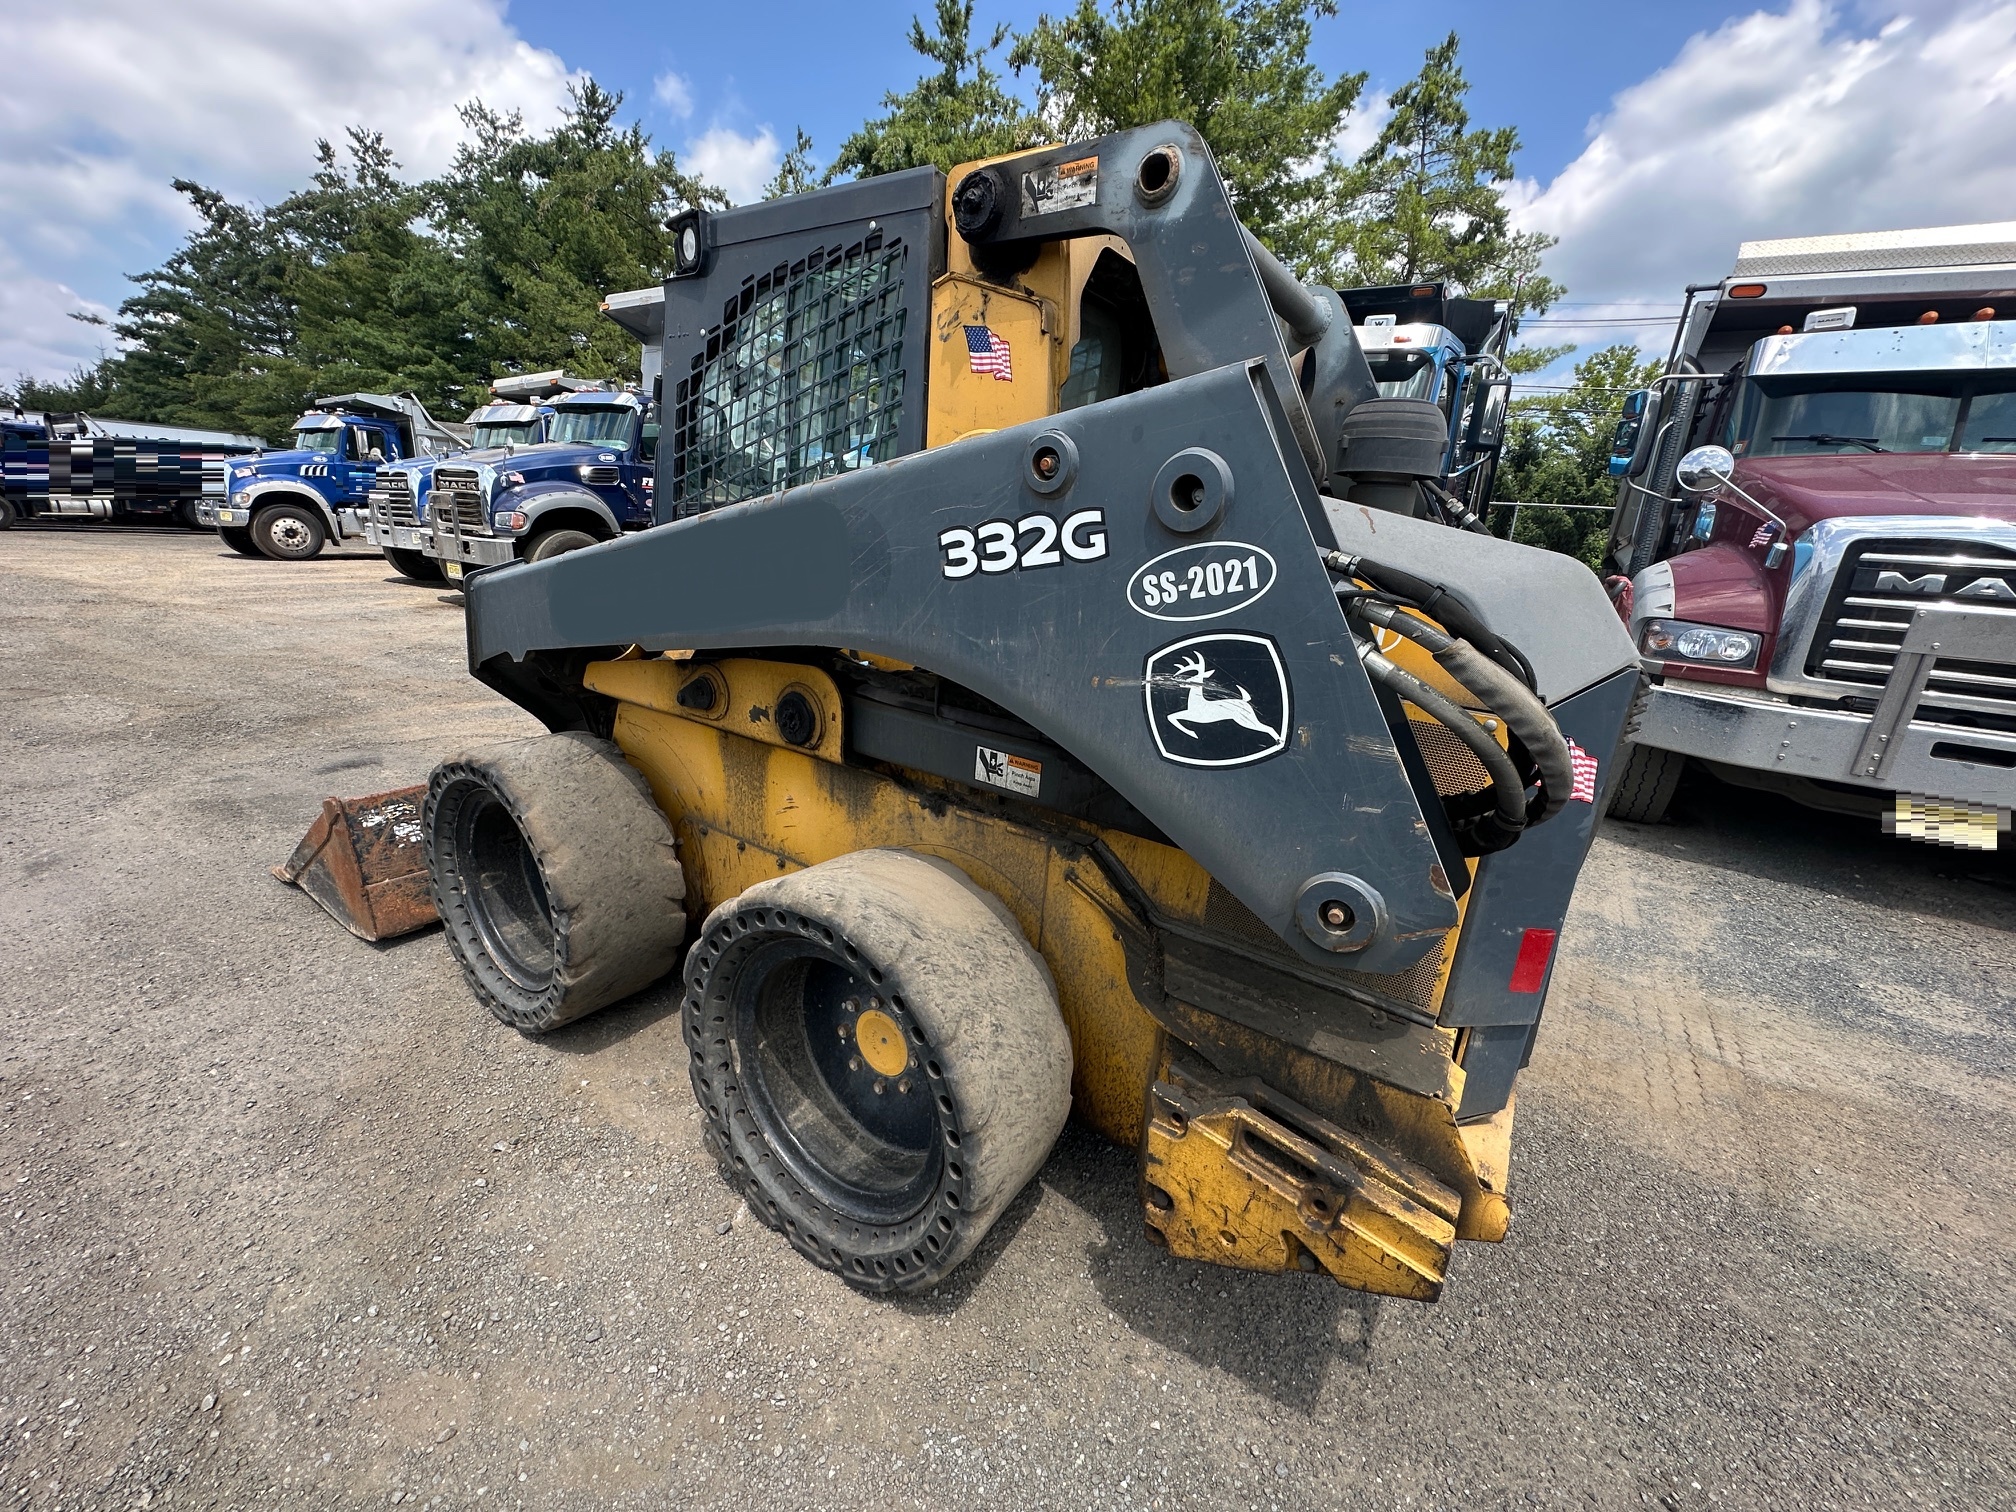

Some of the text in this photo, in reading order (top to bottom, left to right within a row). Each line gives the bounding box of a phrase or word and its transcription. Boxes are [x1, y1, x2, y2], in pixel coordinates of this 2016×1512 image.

[1066, 161, 1095, 174] WARNING
[440, 480, 477, 490] MACK
[939, 509, 1108, 579] 332G
[1142, 556, 1259, 606] SS-2021
[1014, 760, 1039, 770] WARNING
